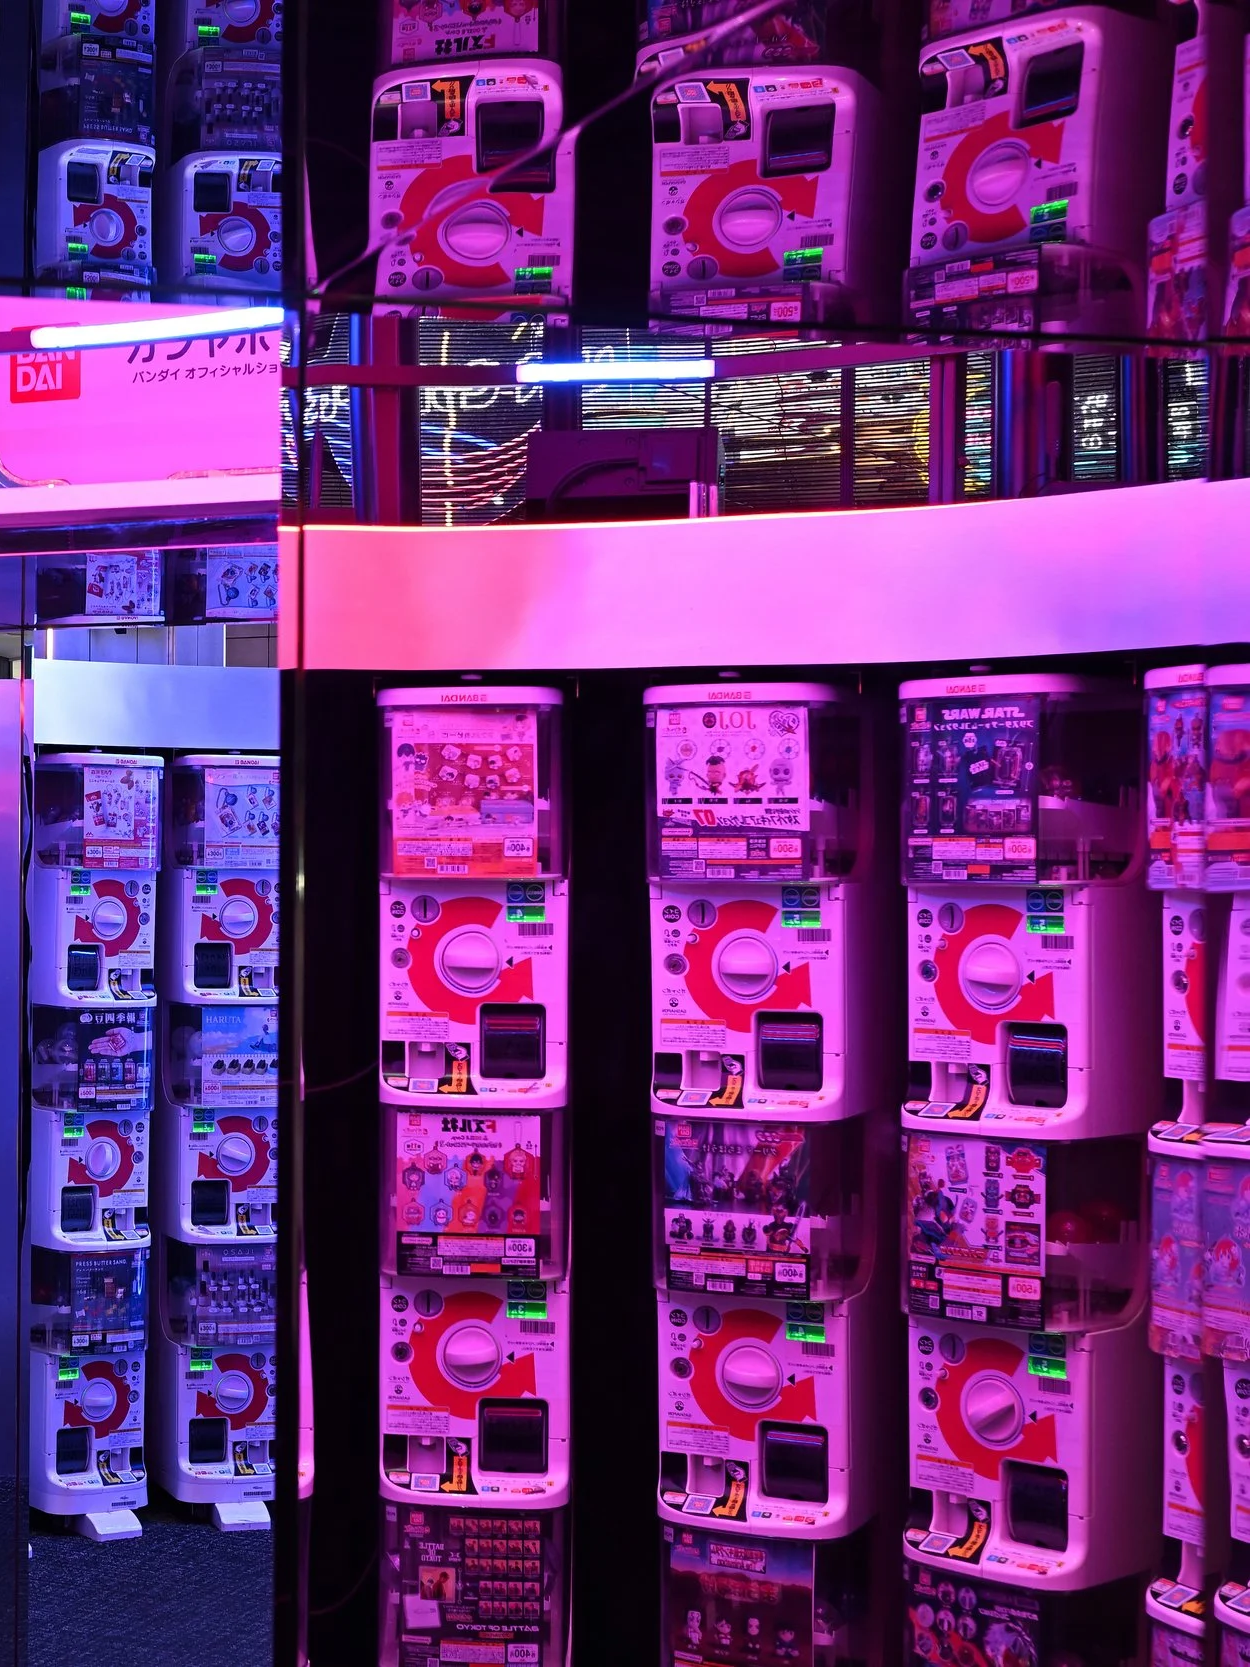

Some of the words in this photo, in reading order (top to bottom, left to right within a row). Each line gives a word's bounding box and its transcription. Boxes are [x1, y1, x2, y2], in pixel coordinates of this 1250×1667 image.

[16, 363, 63, 394] DAI
[132, 368, 180, 384] バンダイ
[184, 362, 278, 380] オフィシャルショ
[95, 1011, 137, 1025] 豆四季報
[205, 1015, 242, 1025] HARUTA
[223, 1248, 255, 1257] OSAJI
[75, 1260, 92, 1268] PRESS
